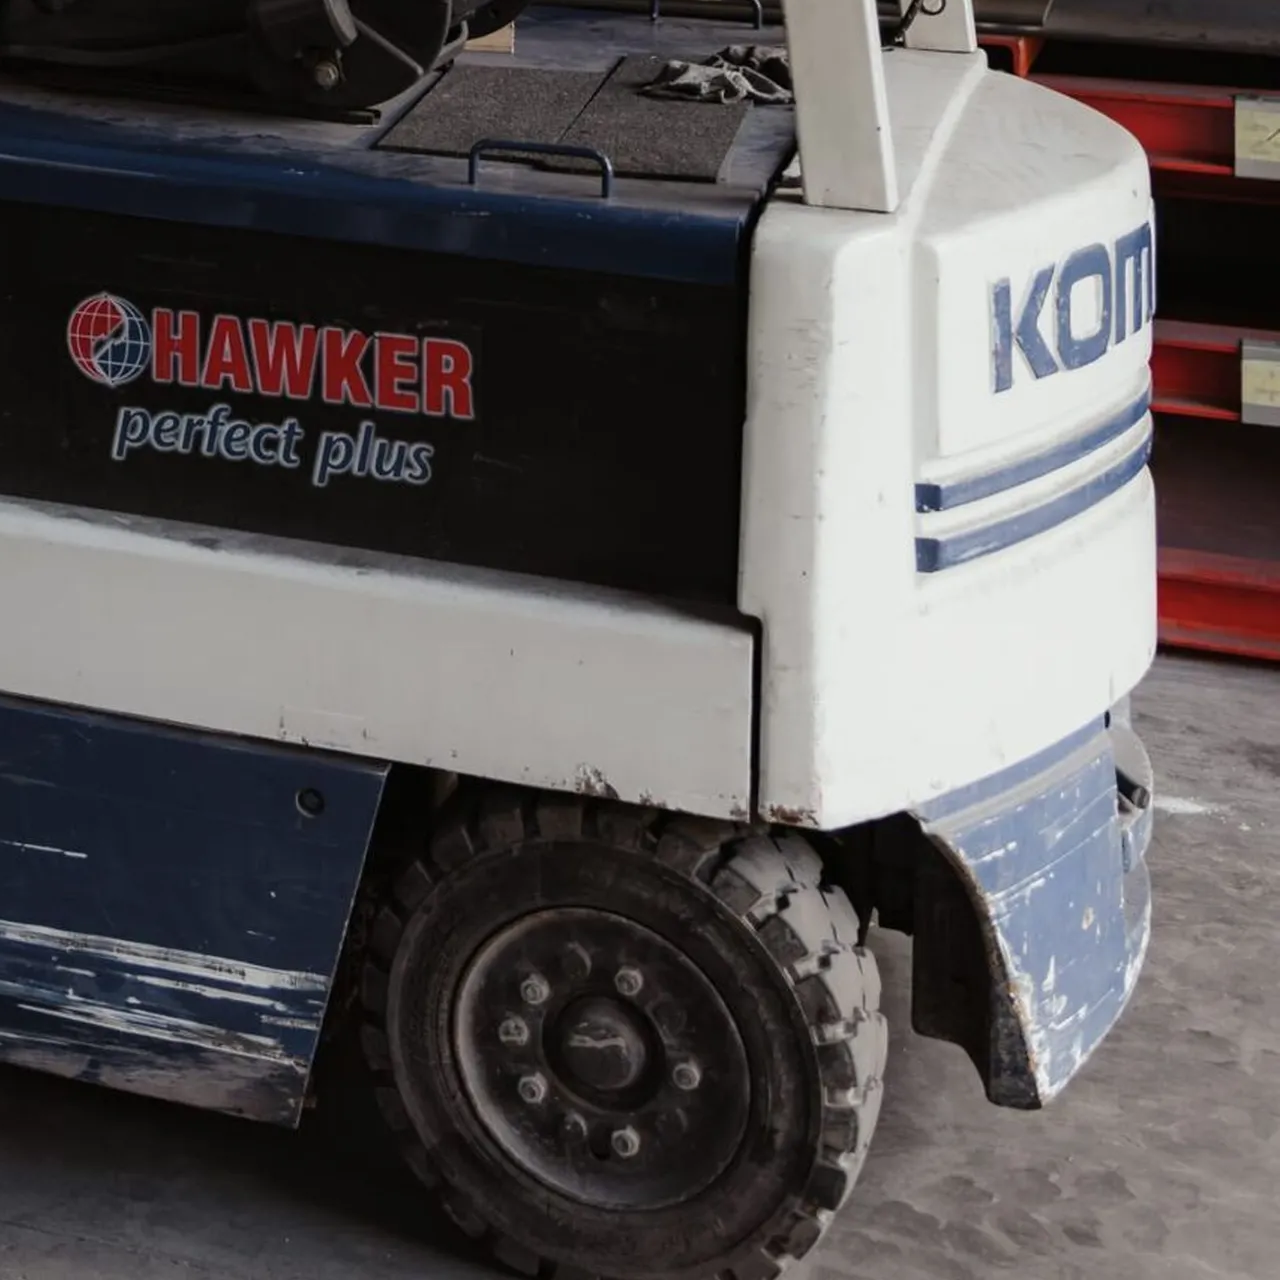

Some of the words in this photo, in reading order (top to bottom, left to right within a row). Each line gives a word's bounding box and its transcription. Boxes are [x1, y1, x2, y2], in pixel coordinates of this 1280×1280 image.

[151, 307, 475, 419] HAWKER
[111, 403, 303, 467] perfect
[312, 421, 434, 487] plus
